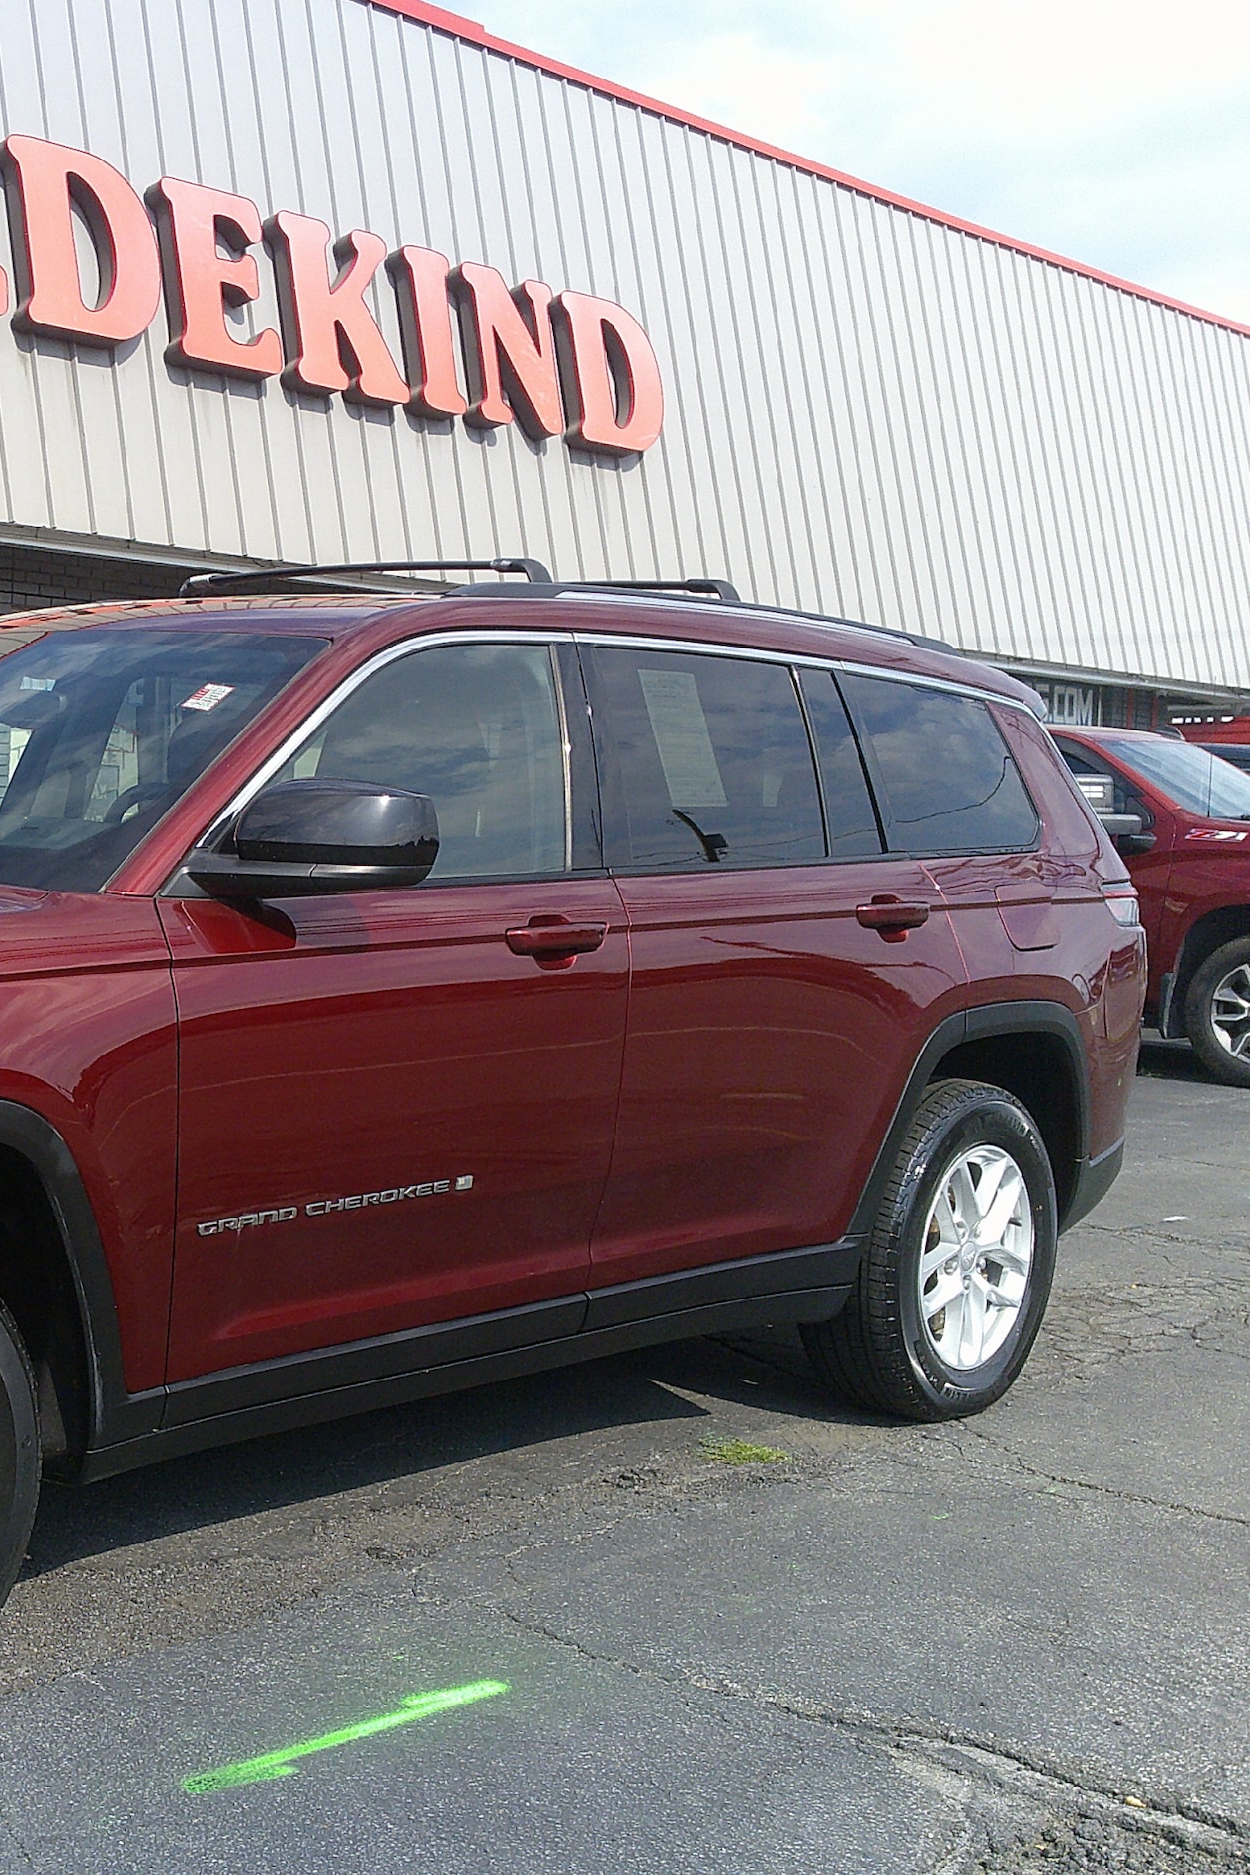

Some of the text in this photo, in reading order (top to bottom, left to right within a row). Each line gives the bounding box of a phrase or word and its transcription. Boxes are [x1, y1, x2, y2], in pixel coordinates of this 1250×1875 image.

[1184, 828, 1248, 842] Z71
[198, 1206, 298, 1236] GRAND
[305, 1179, 451, 1217] CHEROKEE
